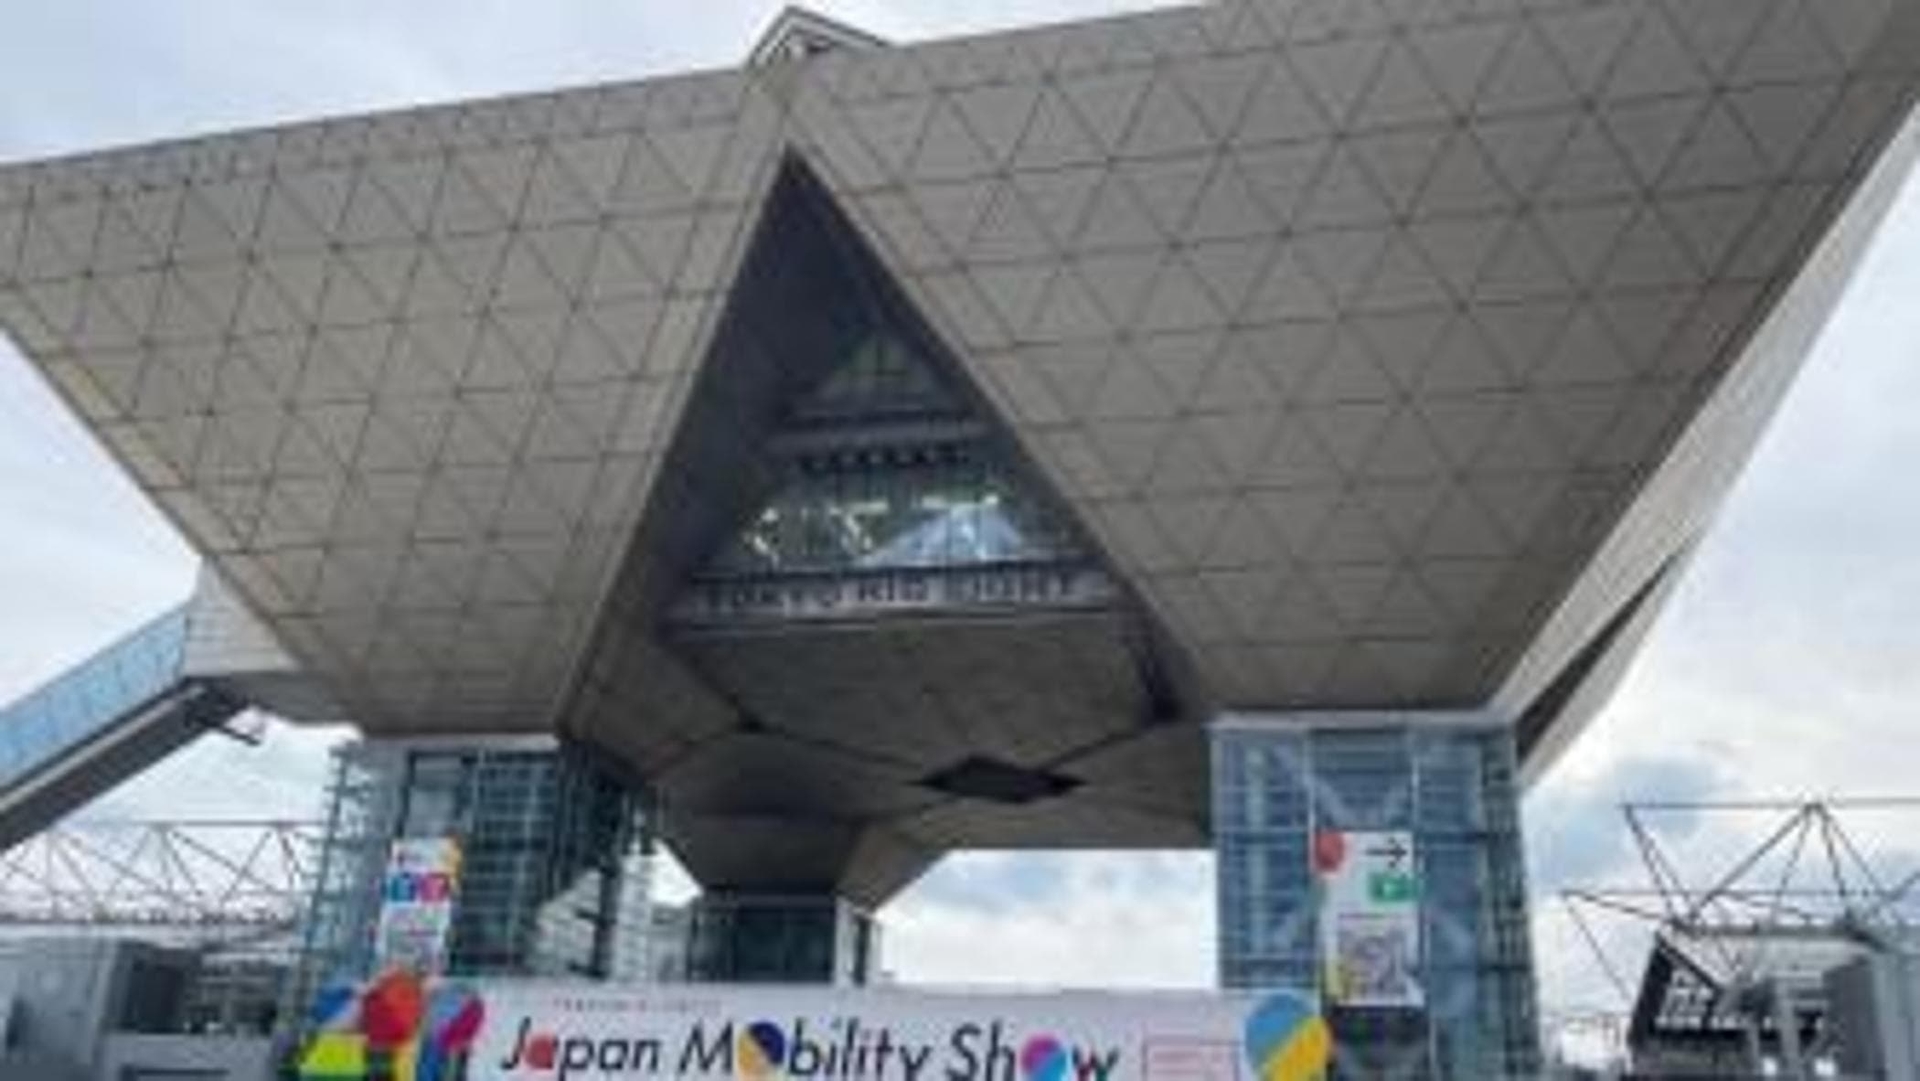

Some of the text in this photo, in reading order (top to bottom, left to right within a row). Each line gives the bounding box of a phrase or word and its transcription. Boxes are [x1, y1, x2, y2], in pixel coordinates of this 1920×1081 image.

[501, 1017, 661, 1081] Japan
[680, 1019, 932, 1081] Mobility
[945, 1019, 1119, 1081] Show
